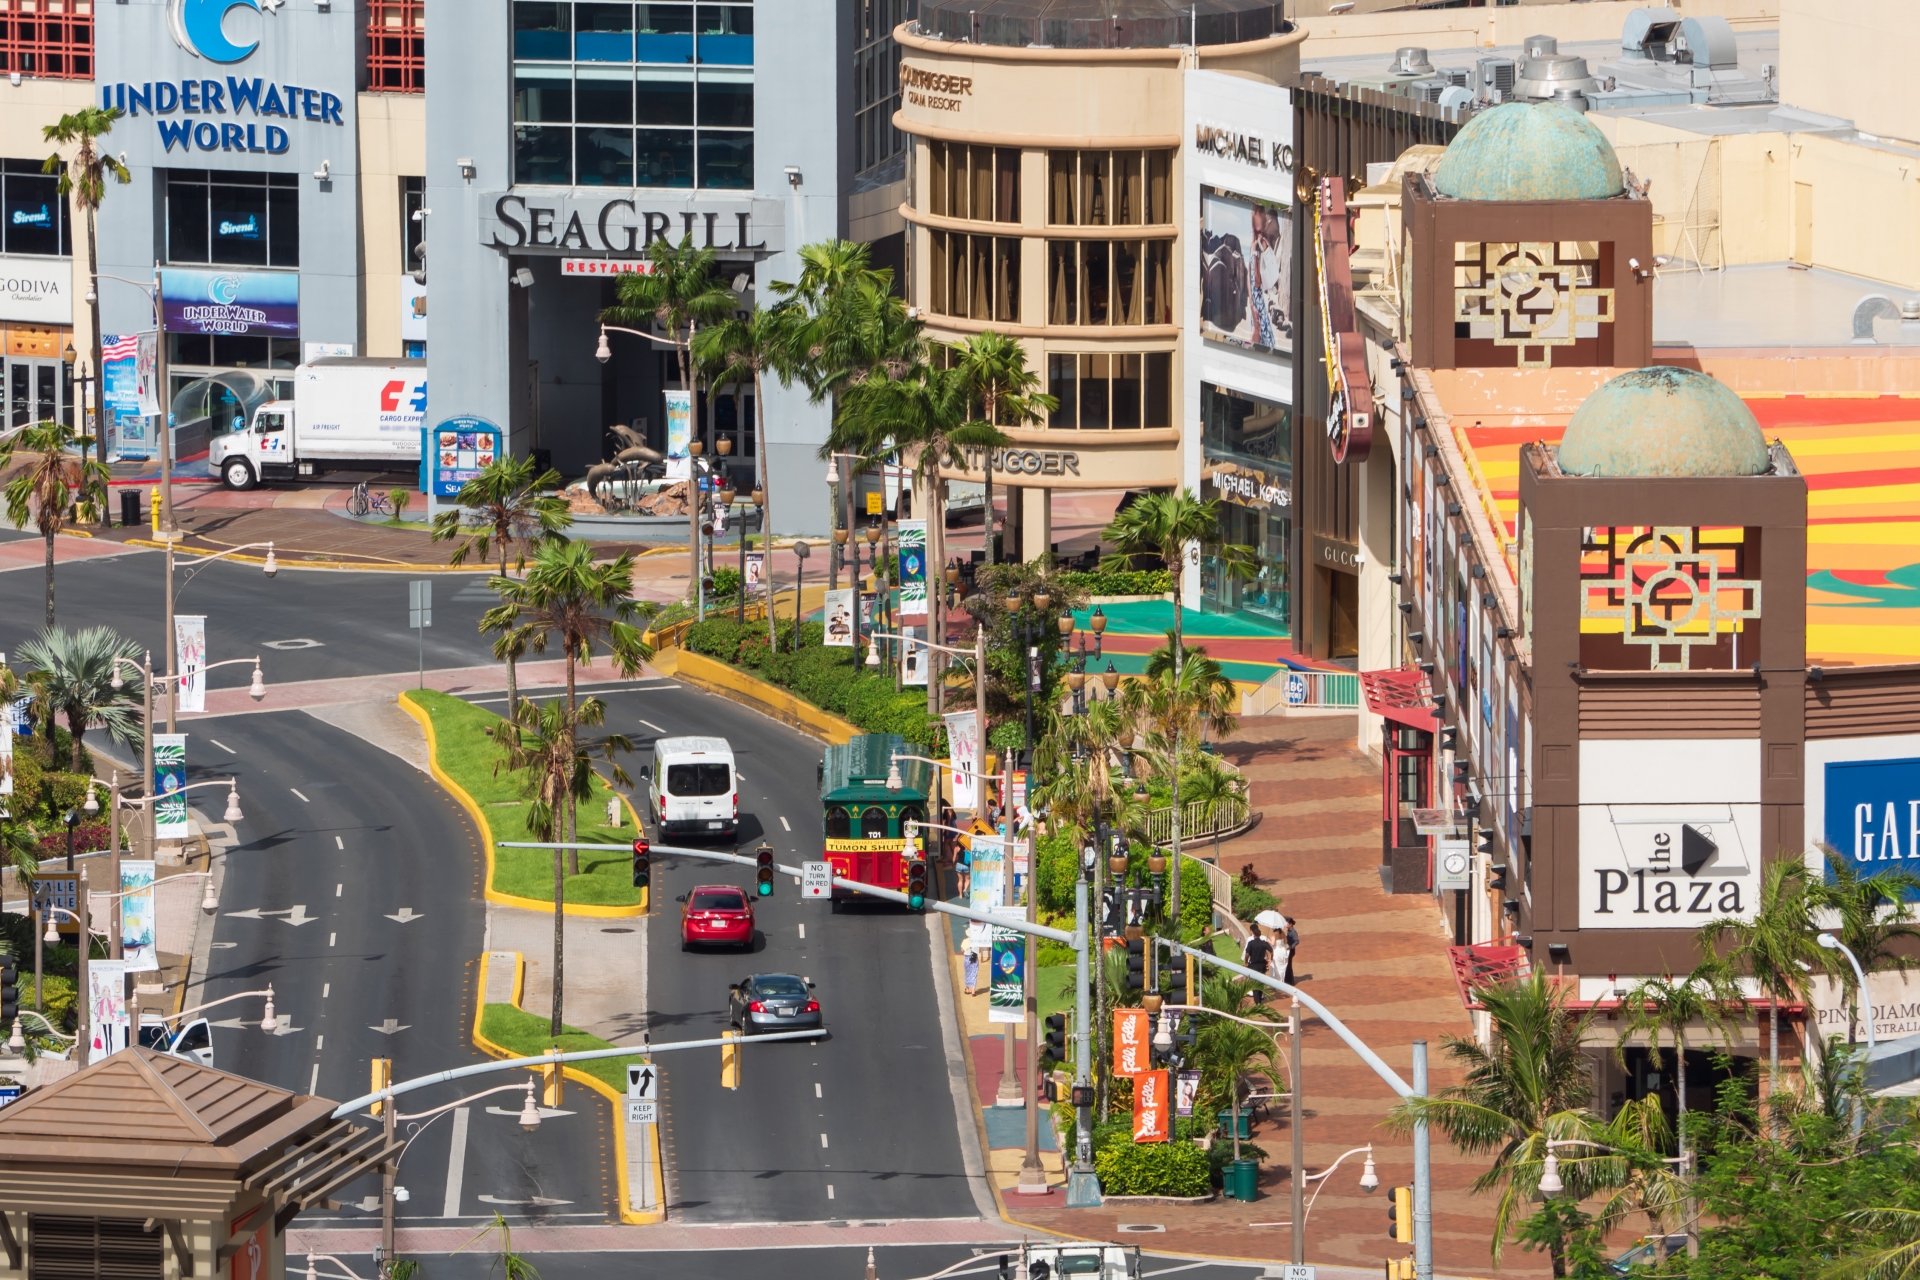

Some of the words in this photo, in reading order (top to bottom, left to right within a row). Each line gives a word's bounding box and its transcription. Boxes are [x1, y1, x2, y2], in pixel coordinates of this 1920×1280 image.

[909, 91, 926, 107] GUAM
[928, 96, 962, 112] RESORT
[157, 119, 290, 151] WORLD
[1196, 124, 1266, 165] MICHAEL
[13, 211, 46, 223] Sirena
[219, 221, 254, 234] Sirena
[11, 293, 43, 302] Chocolatier
[202, 319, 248, 333] WORLD
[1213, 471, 1256, 498] MICHAEL
[1260, 484, 1288, 507] KORS
[871, 843, 920, 851] SHUTE
[1649, 832, 1671, 875] the
[1594, 868, 1745, 914] Plaza
[1870, 1003, 1920, 1020] DIAM
[1121, 1014, 1139, 1045] Follie
[1858, 1021, 1920, 1035] ASTRALI
[1122, 1046, 1142, 1074] Folli
[1142, 1076, 1159, 1108] Follie
[1142, 1110, 1161, 1137] Folli
[1293, 1268, 1306, 1276] NO
